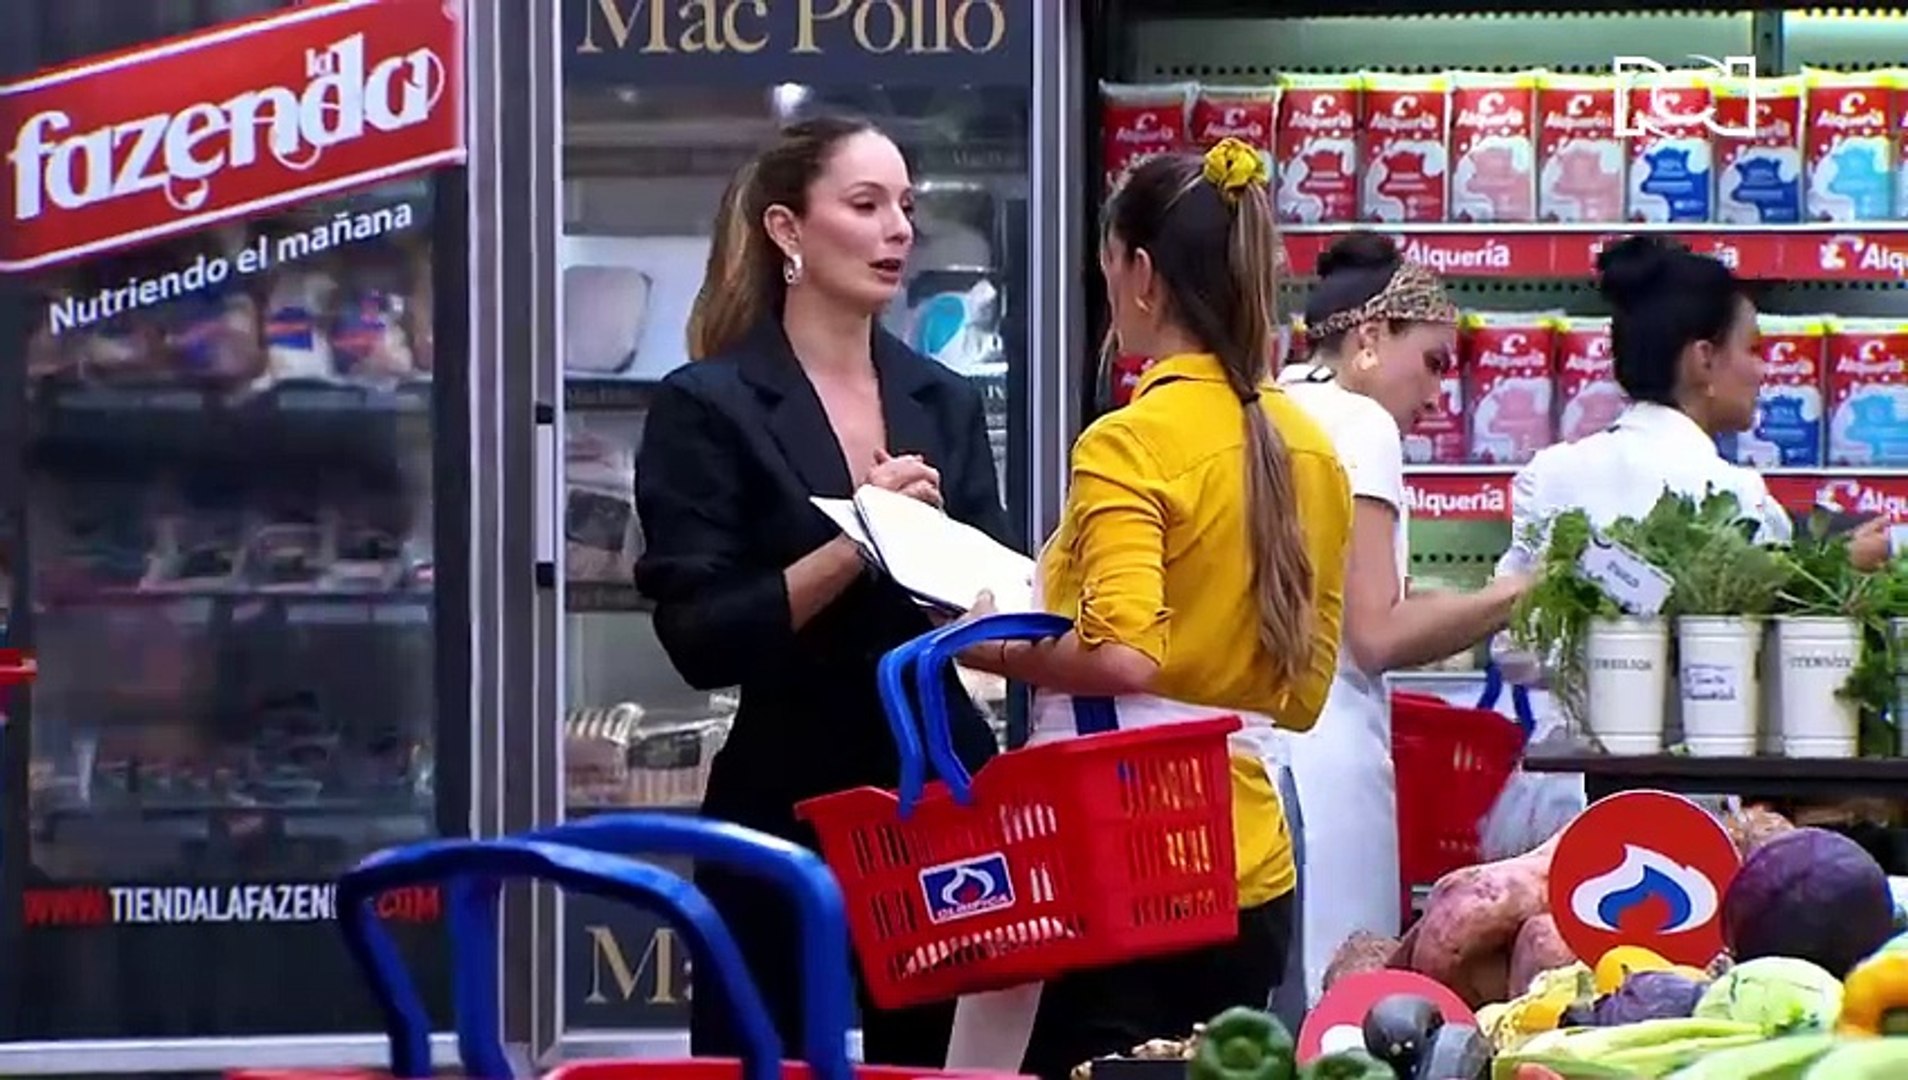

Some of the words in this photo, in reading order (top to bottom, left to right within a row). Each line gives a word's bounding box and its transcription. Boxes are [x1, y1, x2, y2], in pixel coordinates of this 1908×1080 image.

[576, 0, 769, 54] Mac
[7, 33, 446, 221] fazenda
[49, 253, 229, 336] Nutriendo
[236, 238, 269, 275] el
[277, 202, 413, 263] mañana
[1403, 239, 1510, 272] Alquería
